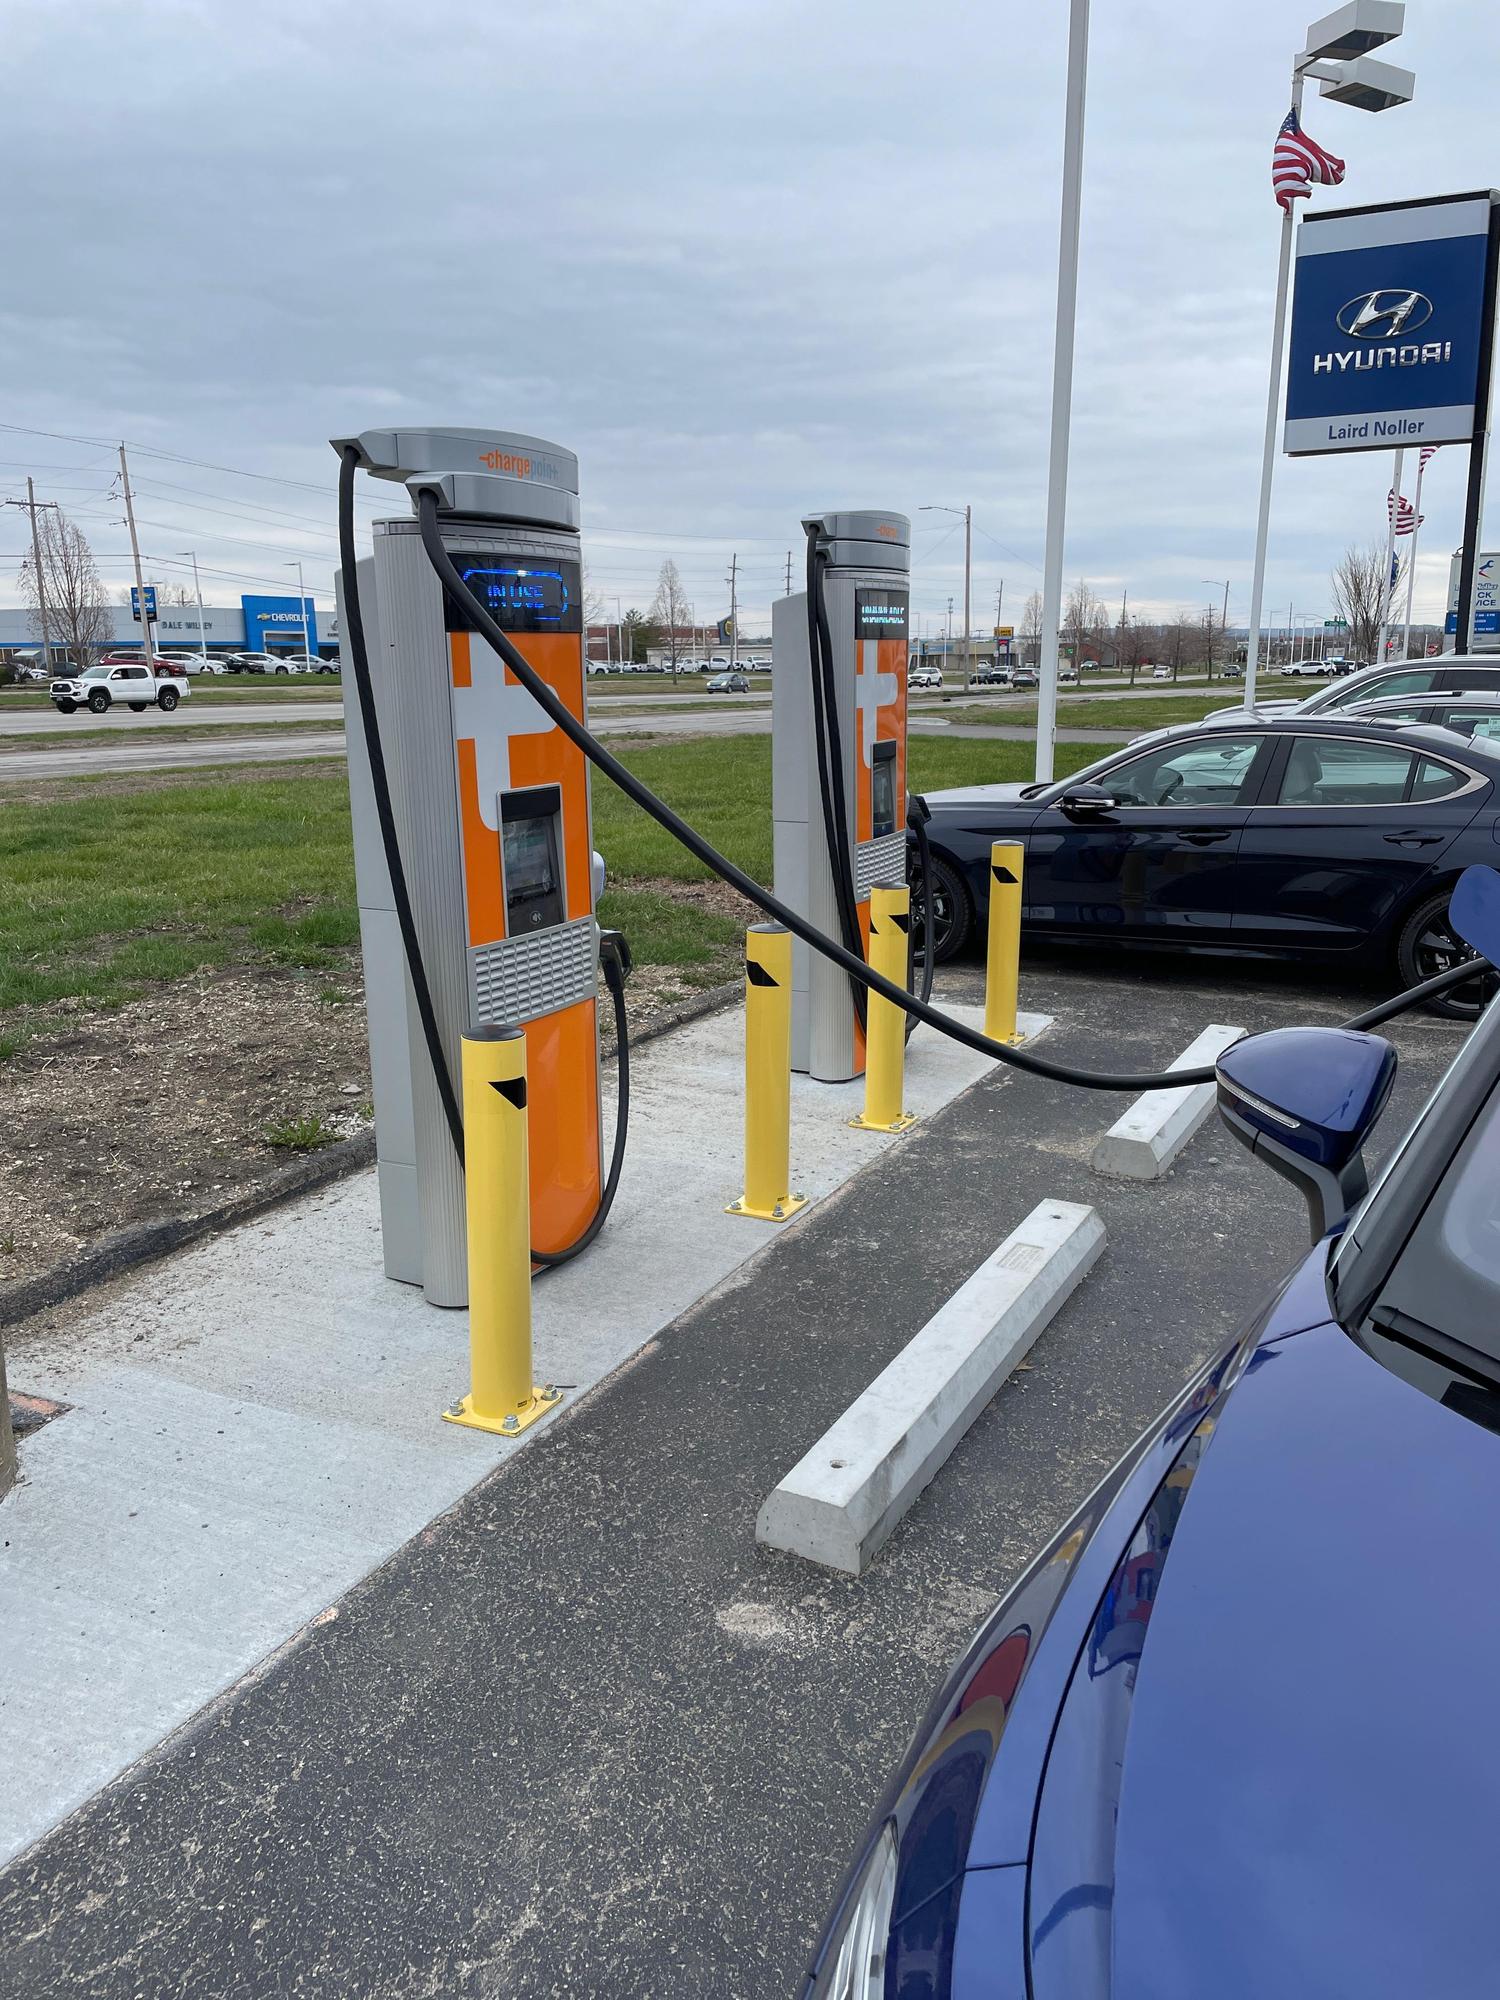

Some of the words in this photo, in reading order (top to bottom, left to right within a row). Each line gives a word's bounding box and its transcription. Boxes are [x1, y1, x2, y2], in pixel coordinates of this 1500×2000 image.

[1313, 341, 1452, 375] HYUNDAI
[1328, 422, 1369, 440] Laird
[1373, 419, 1425, 436] Noller
[271, 613, 310, 622] CHEVROLT
[161, 621, 184, 630] DALE
[185, 621, 213, 630] WILEY
